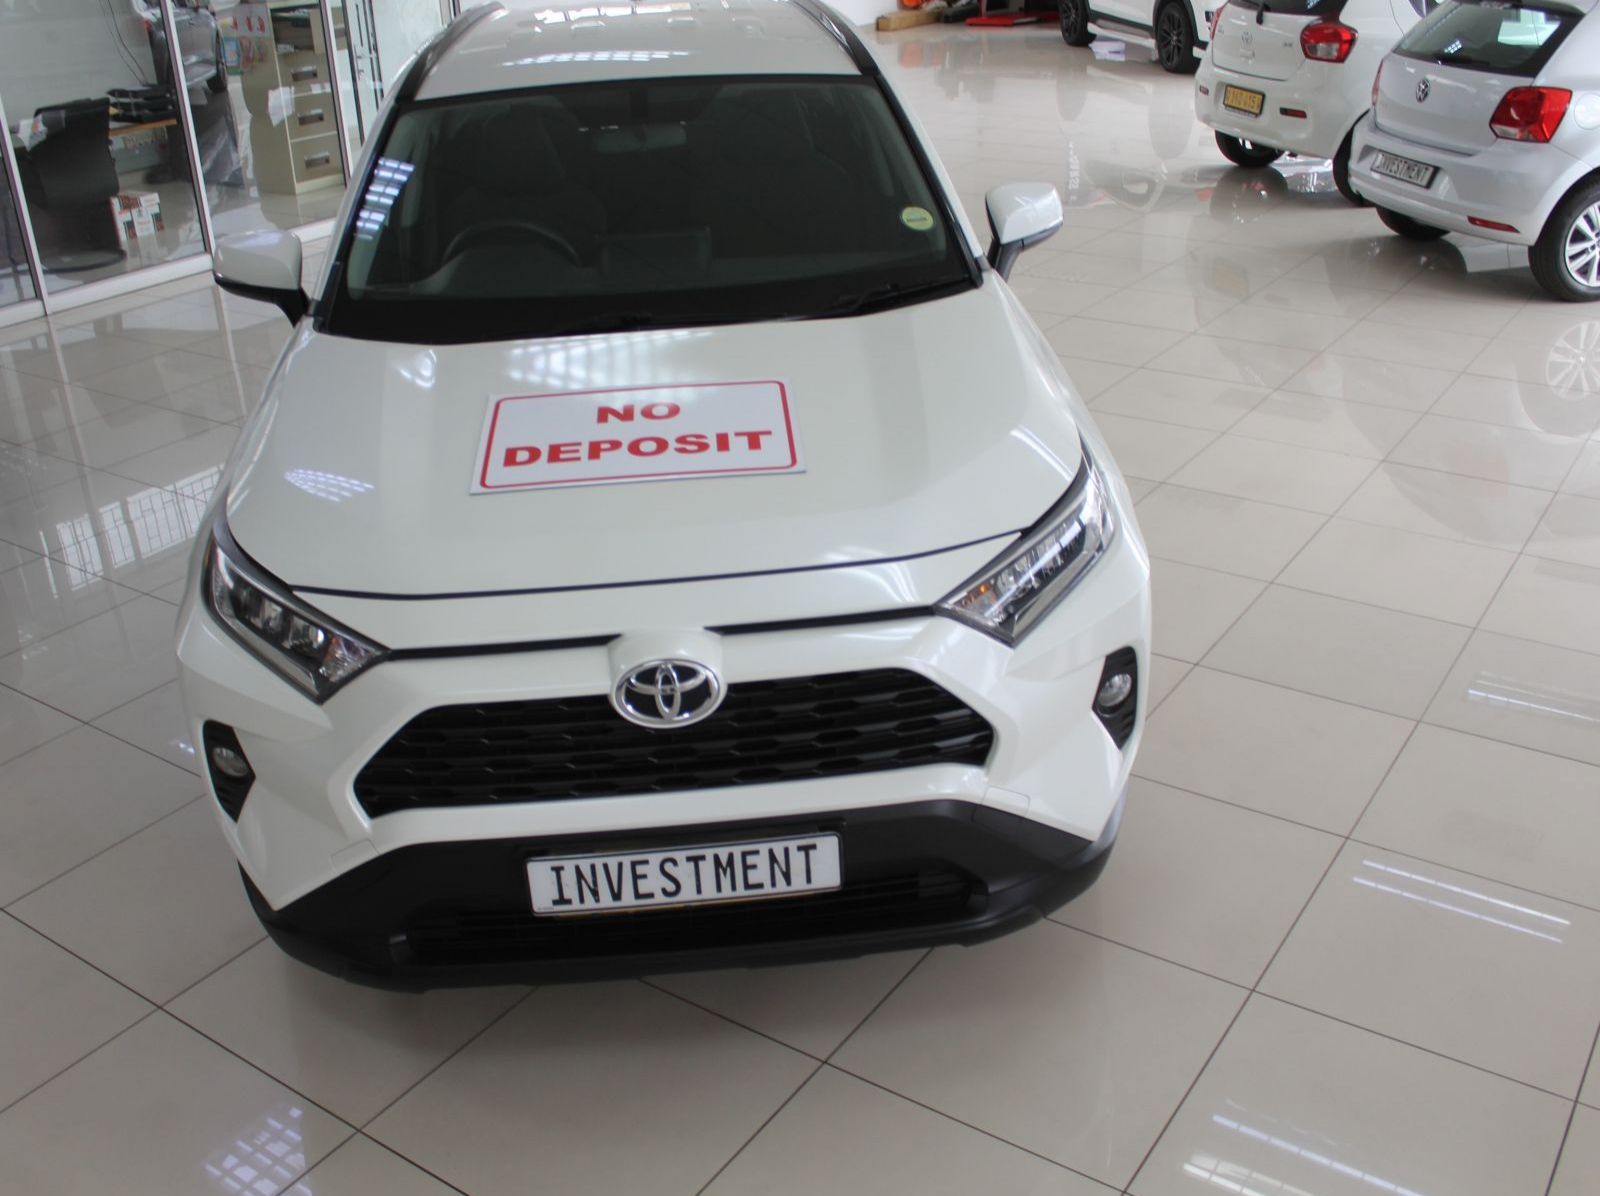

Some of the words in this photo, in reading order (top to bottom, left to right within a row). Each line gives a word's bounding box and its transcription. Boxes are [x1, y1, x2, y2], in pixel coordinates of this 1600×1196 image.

[597, 402, 681, 424] NO
[502, 430, 772, 468] DEPOSIT
[551, 843, 818, 906] INVESTMENT
